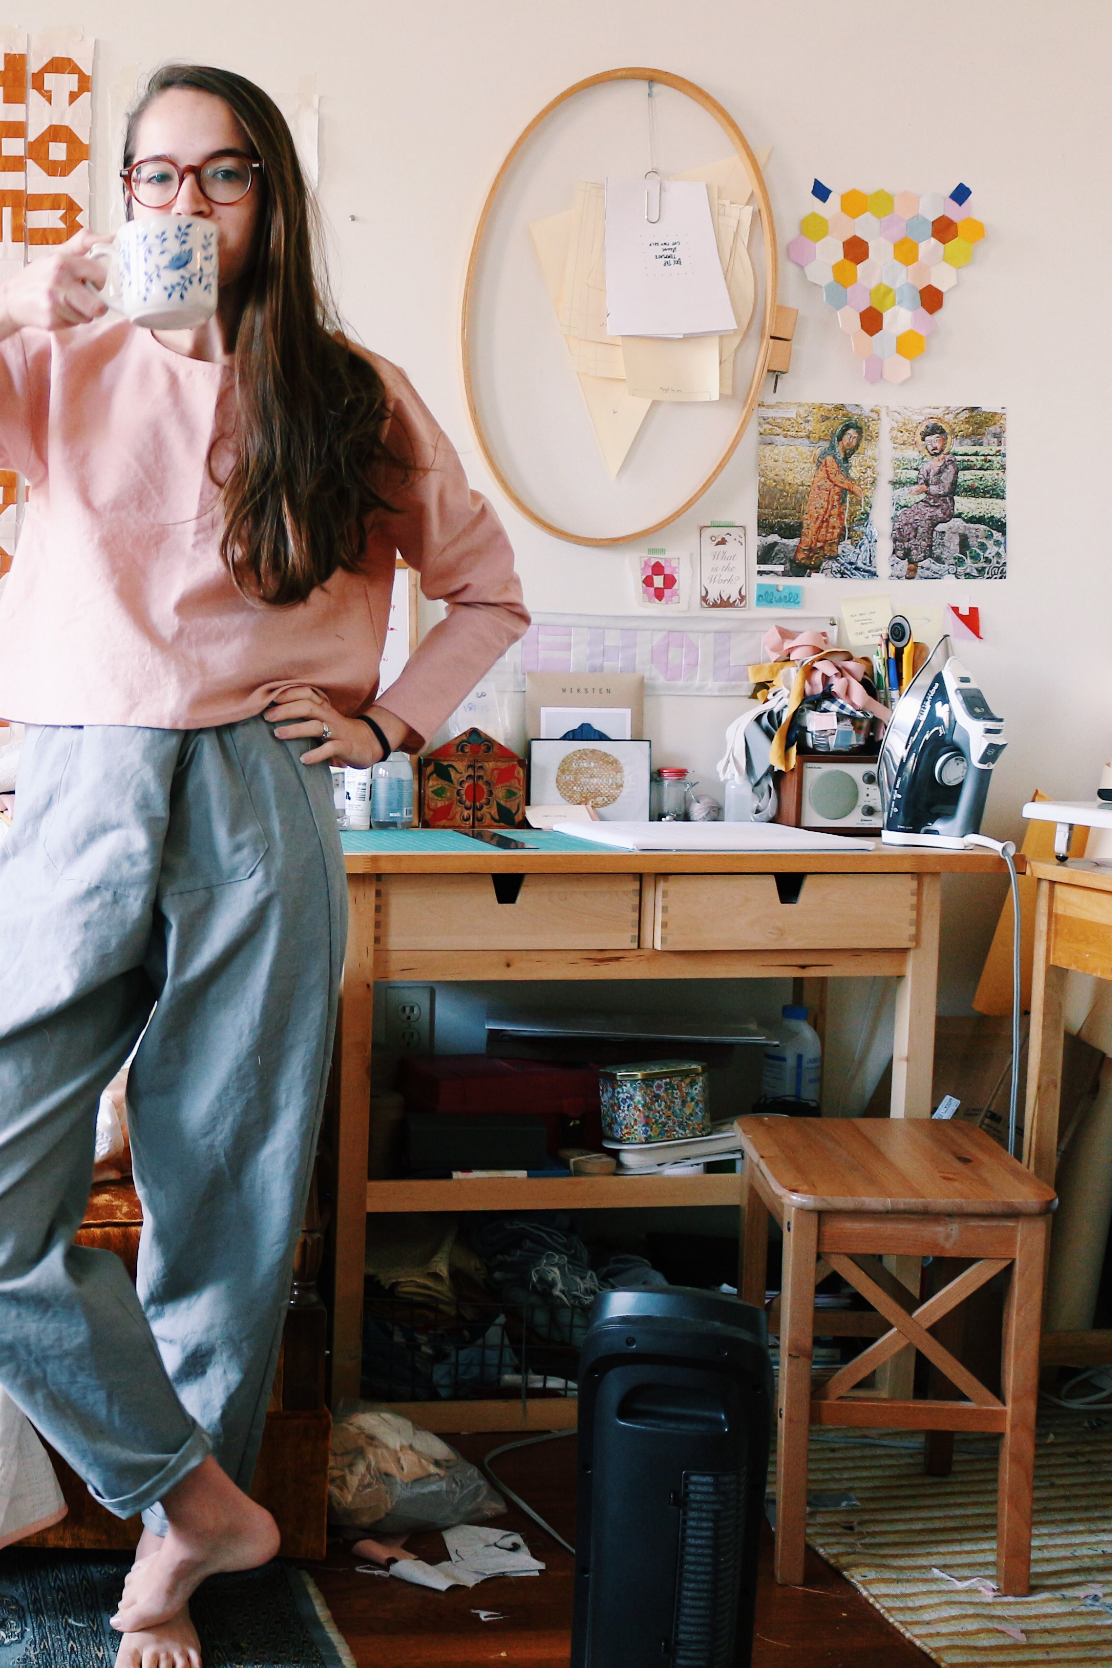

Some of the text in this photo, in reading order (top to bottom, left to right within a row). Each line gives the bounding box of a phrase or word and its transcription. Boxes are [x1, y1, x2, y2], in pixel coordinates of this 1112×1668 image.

[711, 550, 736, 561] What
[721, 563, 736, 572] the
[708, 574, 740, 585] Work?
[561, 687, 611, 695] WIKSTEN
